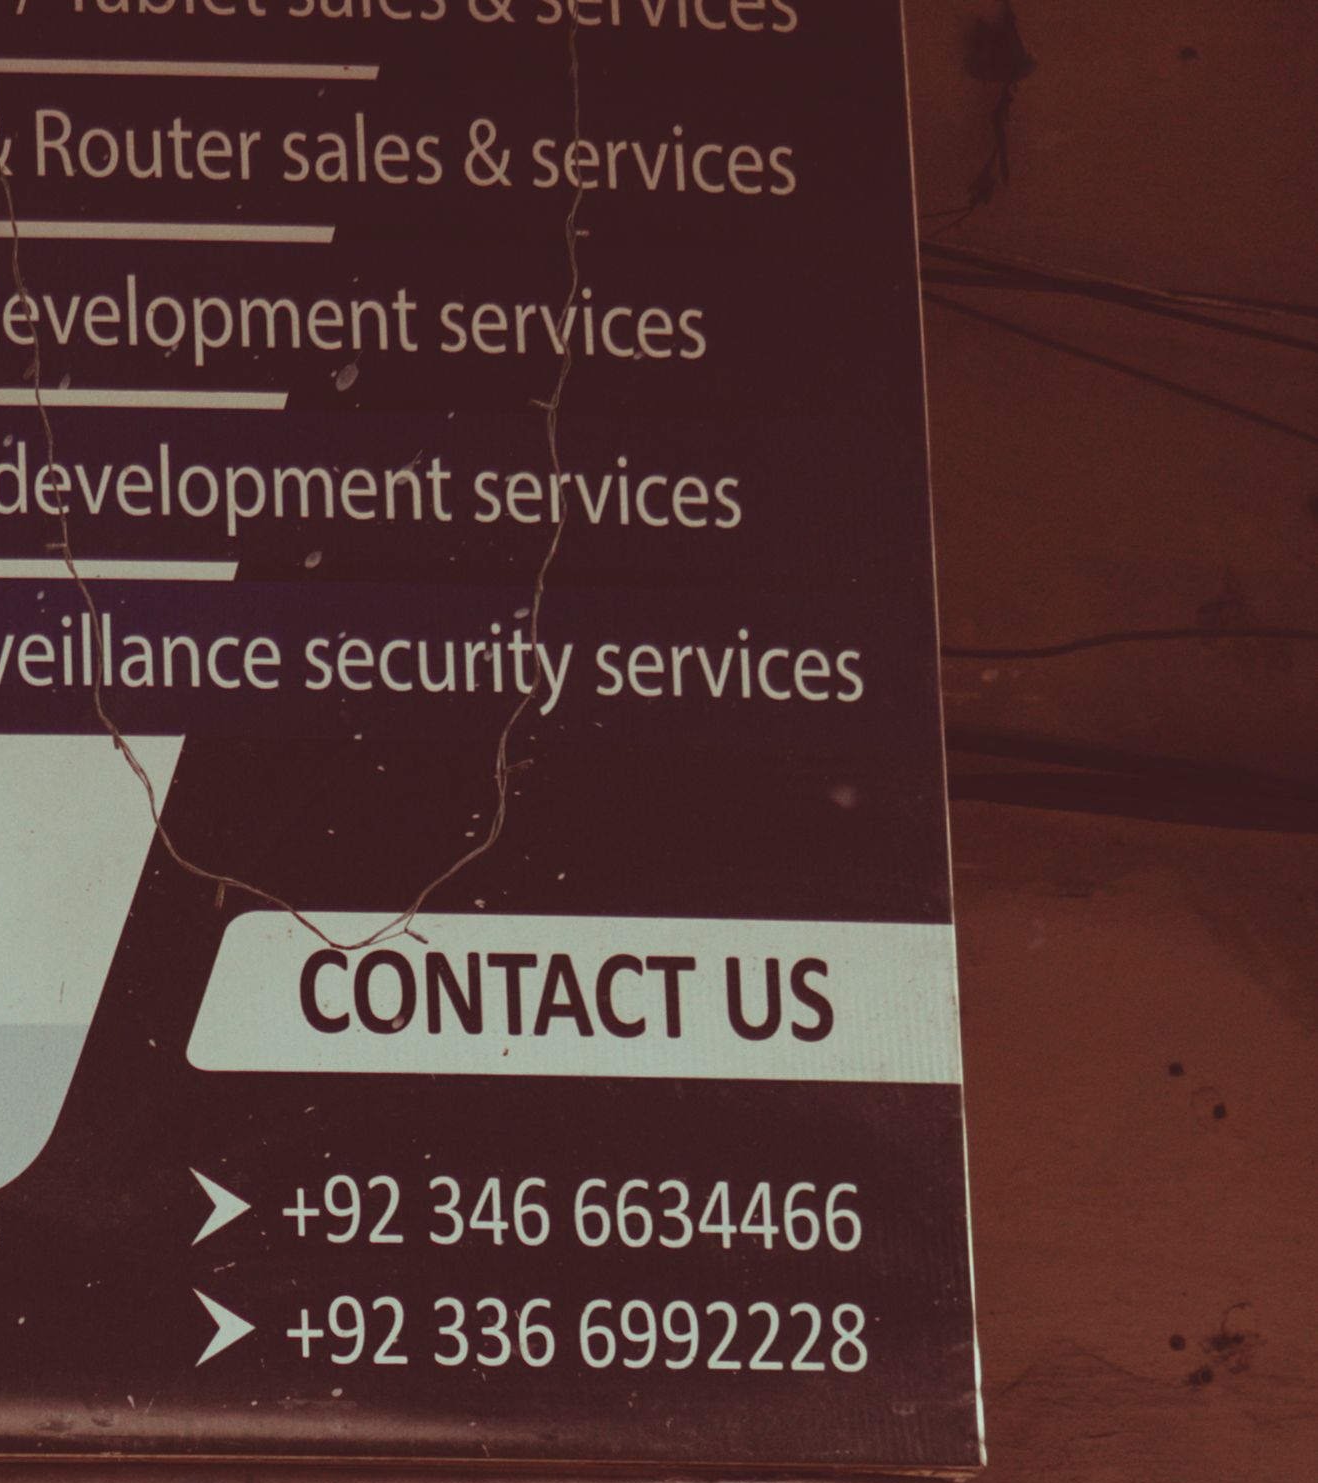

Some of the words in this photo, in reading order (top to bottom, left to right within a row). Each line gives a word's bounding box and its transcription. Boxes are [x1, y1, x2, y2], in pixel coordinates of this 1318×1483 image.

[35, 108, 261, 181] Router
[283, 112, 443, 185] sales
[464, 118, 512, 187] &
[532, 124, 796, 196] services
[440, 287, 707, 360] services
[474, 456, 742, 529] services
[305, 622, 573, 716] security
[596, 628, 864, 702] services
[299, 948, 697, 1039] CONTACT
[725, 956, 834, 1043] US
[282, 1174, 404, 1245] +92
[429, 1175, 550, 1247] 346
[574, 1177, 862, 1252] 6634466
[286, 1295, 409, 1366] +92
[434, 1296, 556, 1369] 336
[579, 1298, 868, 1373] 6992228
